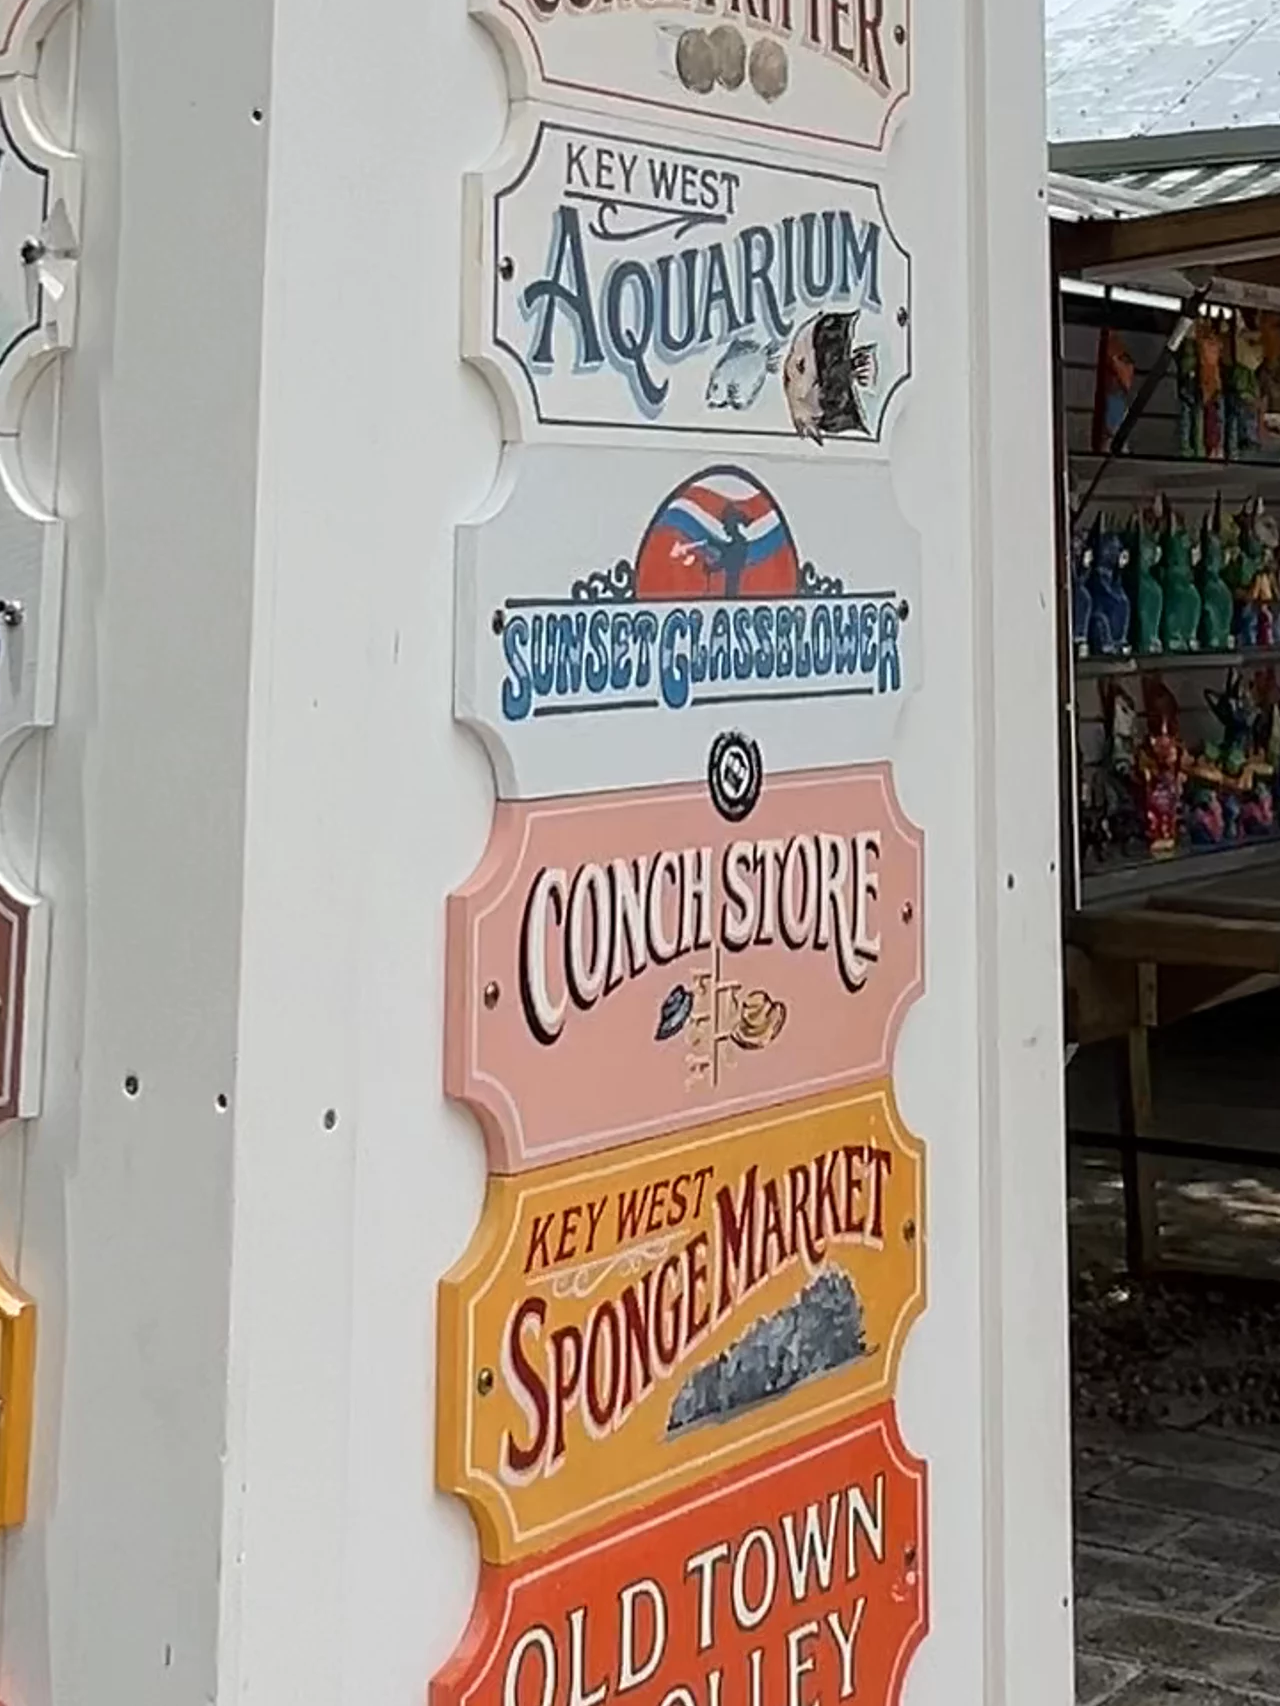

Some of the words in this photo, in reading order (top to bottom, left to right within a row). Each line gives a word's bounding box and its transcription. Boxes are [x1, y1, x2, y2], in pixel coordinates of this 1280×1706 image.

[566, 142, 638, 188] KEY
[649, 161, 740, 214] WEST
[523, 205, 883, 410] AQUARIUM
[501, 607, 657, 721] SUNSET
[659, 603, 902, 710] GLASSBLOWER
[523, 847, 713, 1044] CONCH
[721, 830, 882, 992] STORE
[524, 1196, 610, 1273] KEY
[617, 1166, 714, 1244] WEST
[503, 1231, 709, 1478] SPONGE
[715, 1145, 892, 1317] MARKET
[686, 1474, 885, 1651] TOWN
